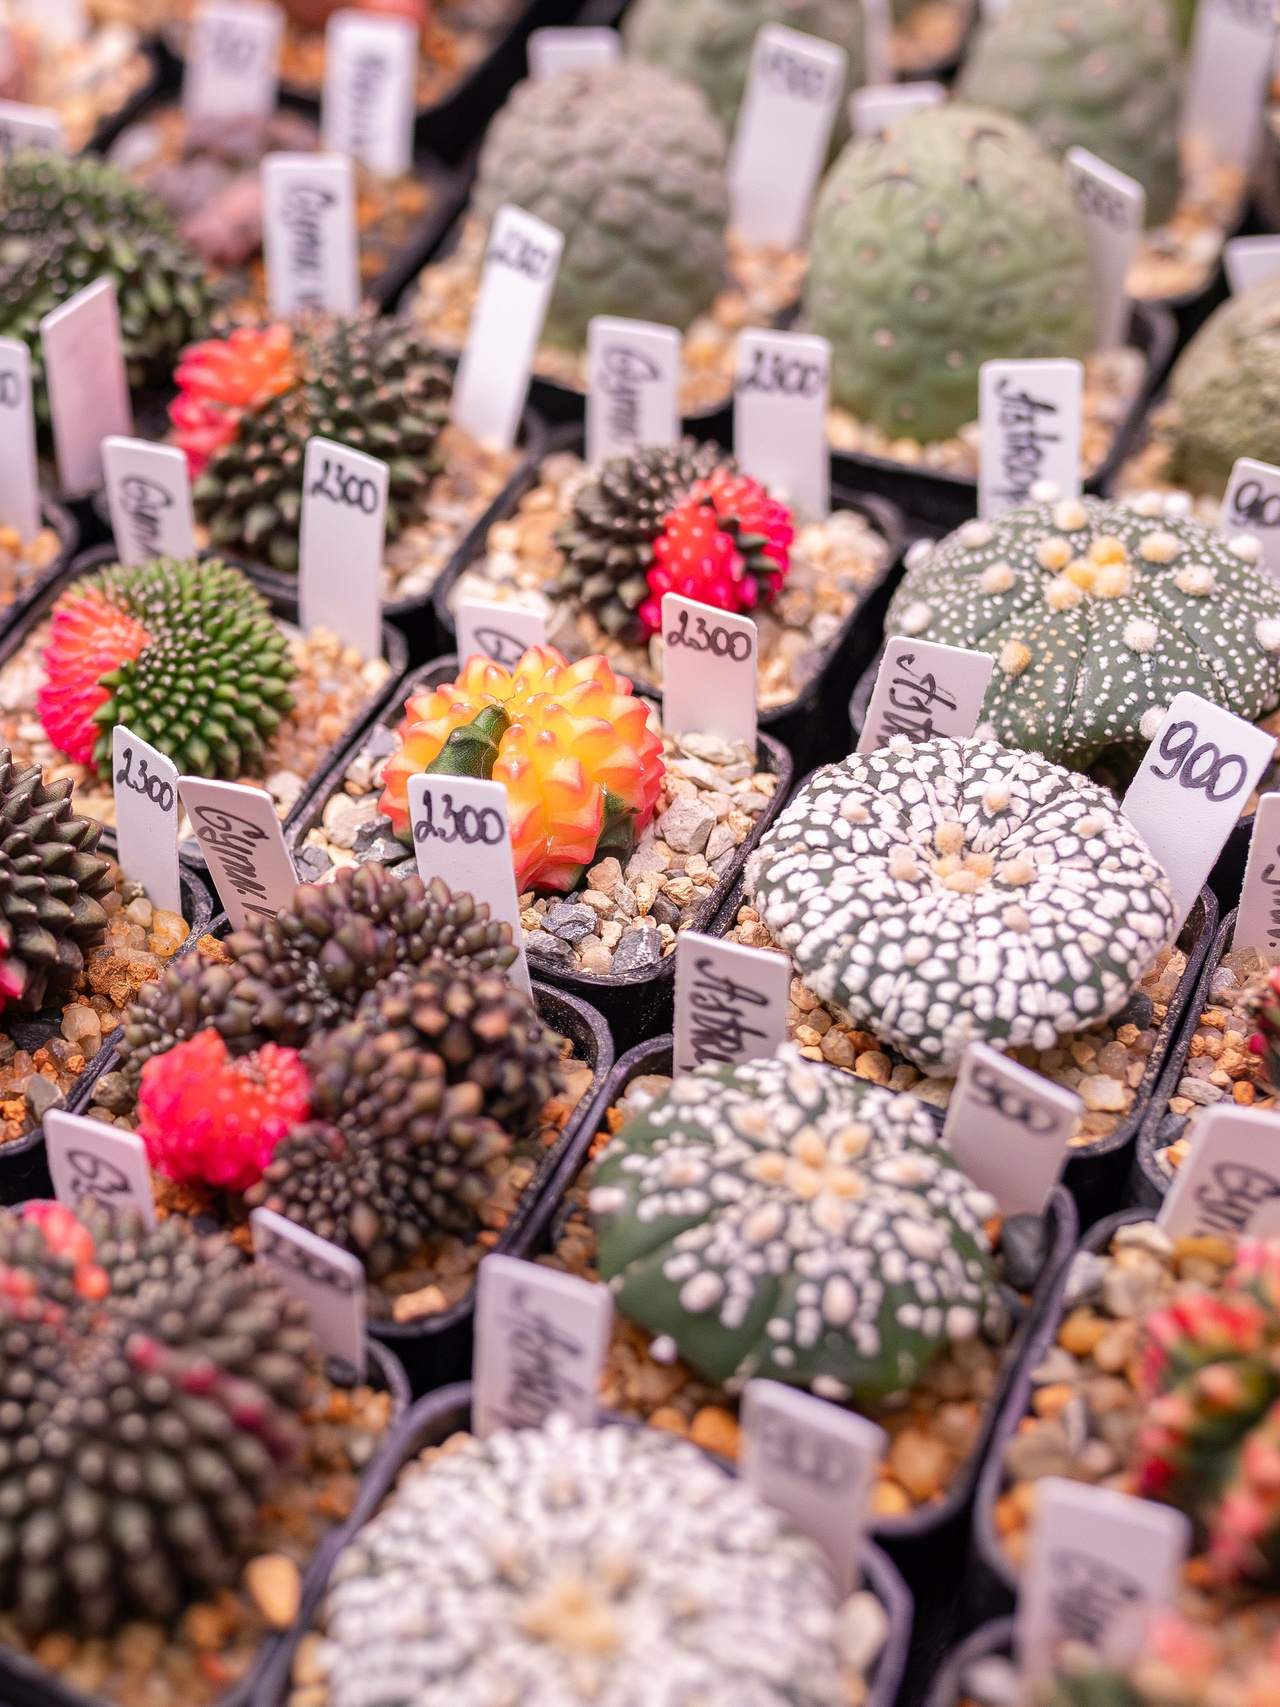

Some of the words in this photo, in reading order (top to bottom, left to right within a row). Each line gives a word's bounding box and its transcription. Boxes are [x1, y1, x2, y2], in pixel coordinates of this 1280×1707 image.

[310, 459, 379, 515] 2300
[667, 608, 751, 661] 2300
[116, 747, 174, 812] 2300
[1149, 720, 1247, 803] 900
[413, 790, 505, 846] 2300
